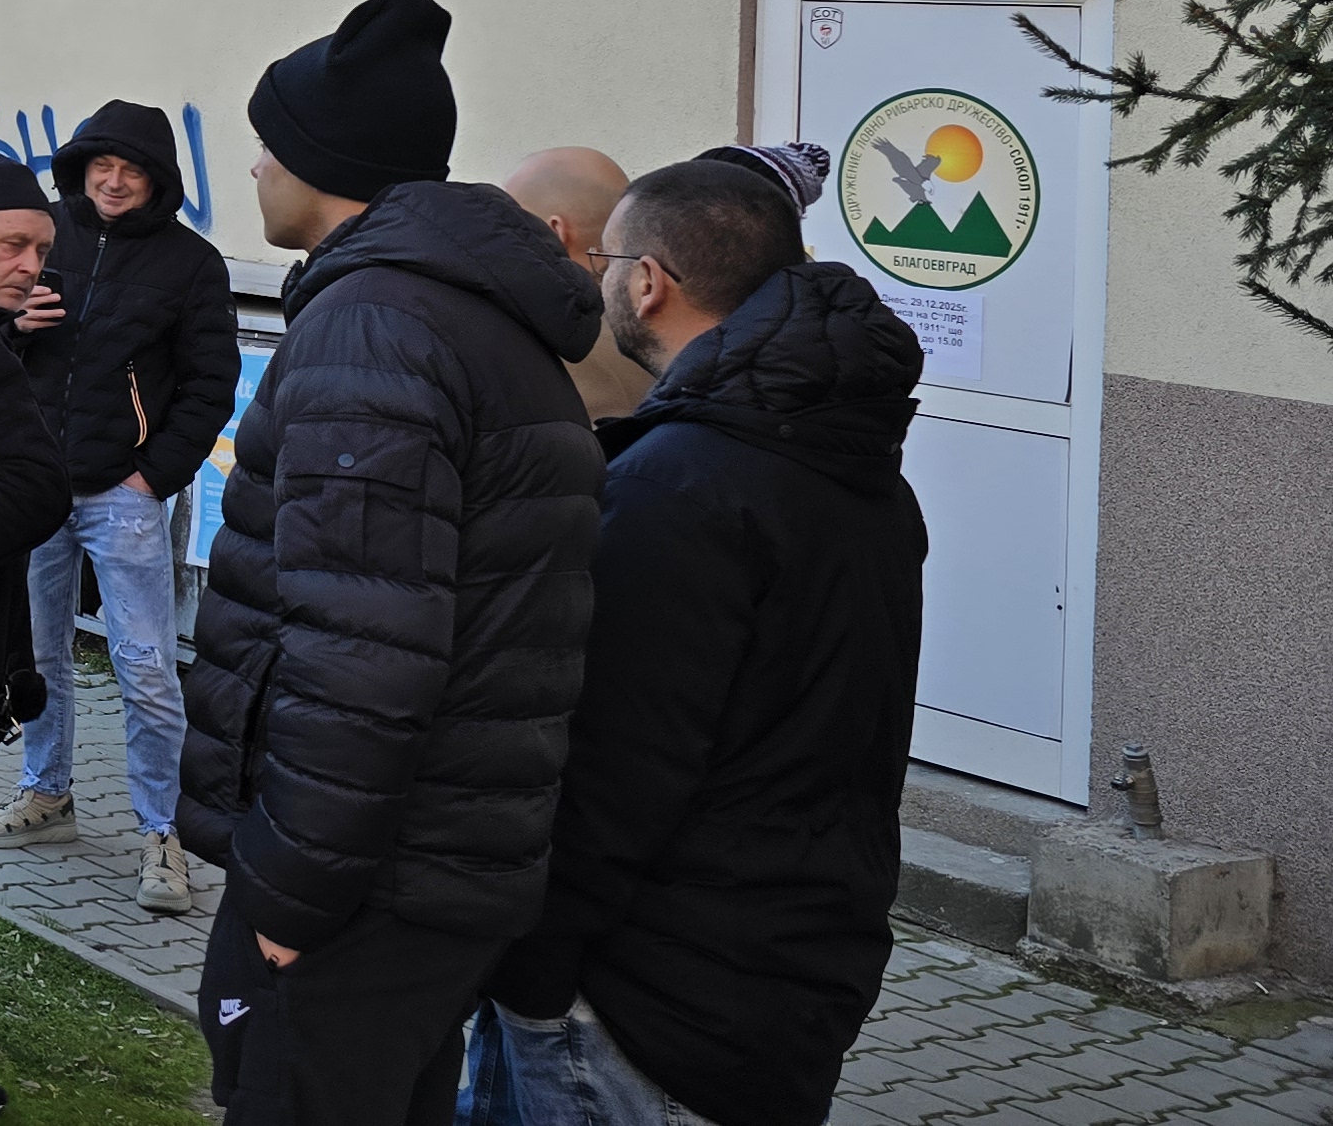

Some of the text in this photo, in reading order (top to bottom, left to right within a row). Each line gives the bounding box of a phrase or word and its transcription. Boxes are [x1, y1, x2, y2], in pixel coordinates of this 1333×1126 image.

[845, 150, 862, 221] СДРУЖЕНИЕ
[856, 116, 887, 149] ЛОВНО
[886, 96, 945, 120] РИБАРСКО
[946, 98, 1013, 146] ДРУЖЕСТВО
[1009, 149, 1031, 192] СОКОЛ
[893, 255, 977, 276] БЛАГОЕВГРАД
[916, 311, 928, 320] на
[948, 327, 963, 336] ще
[921, 335, 963, 347] до 15.00
